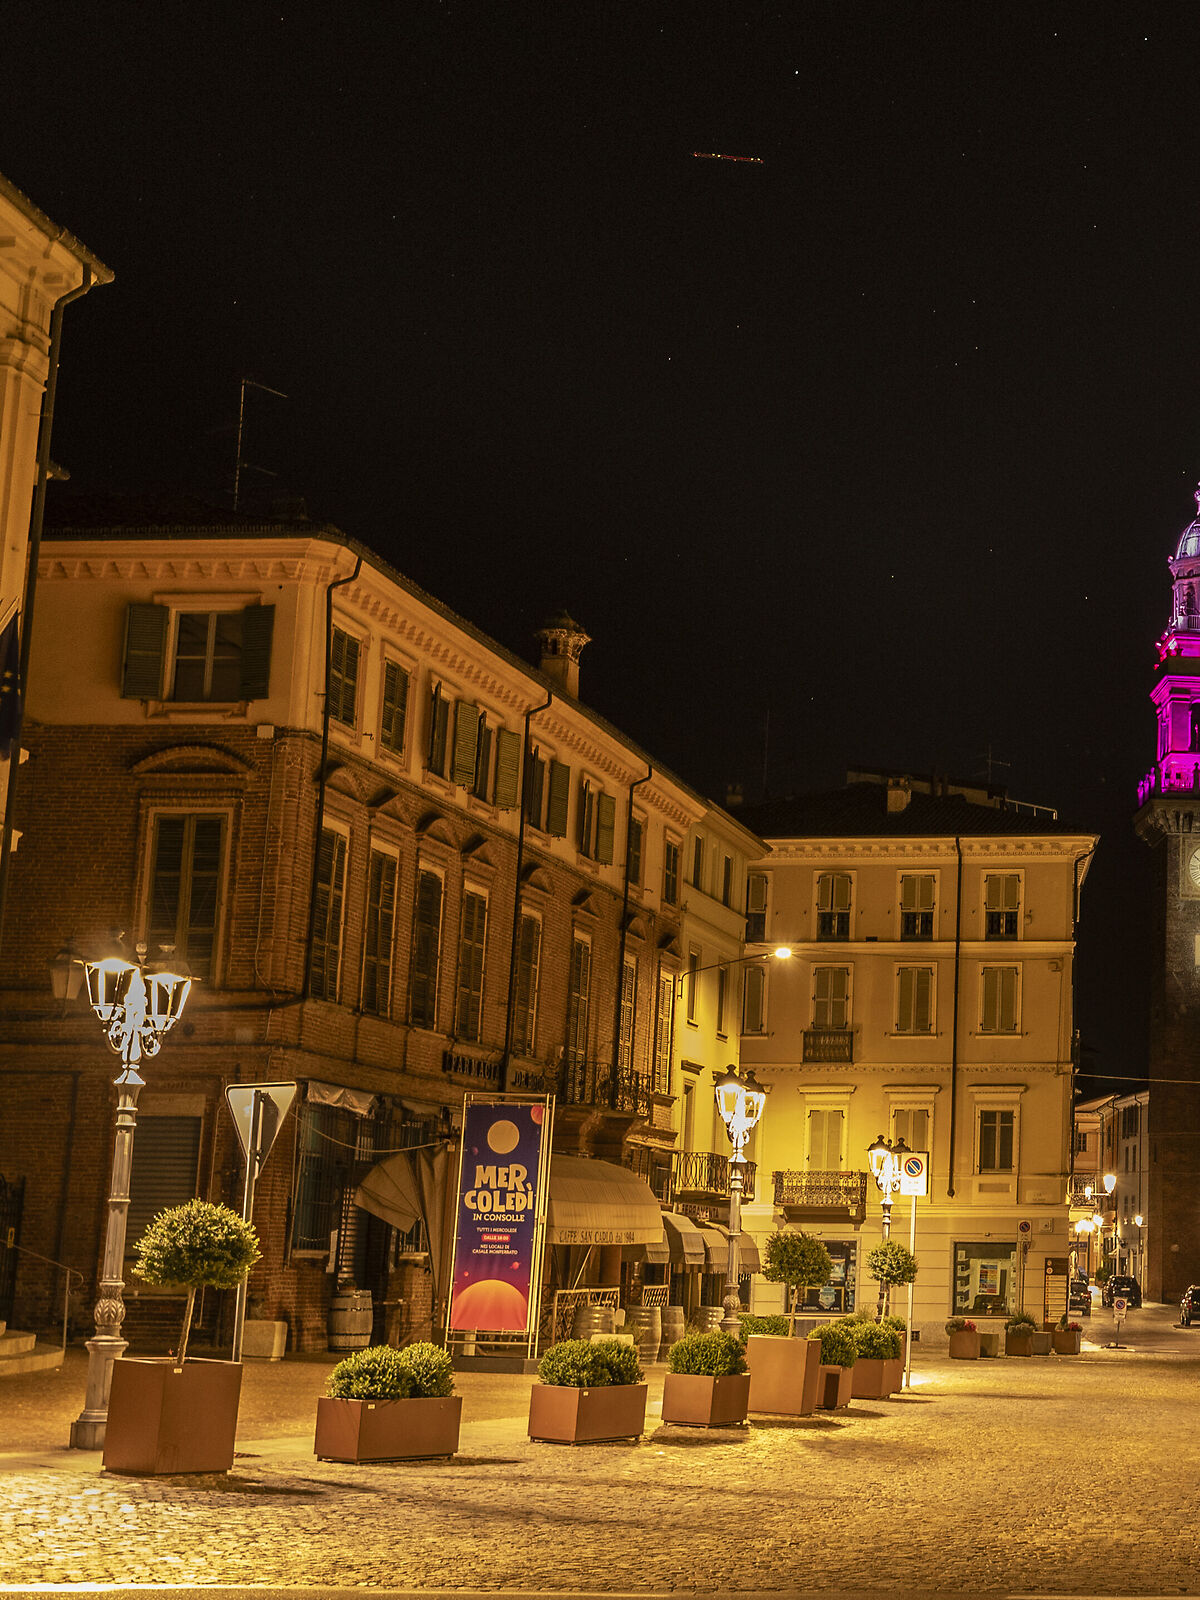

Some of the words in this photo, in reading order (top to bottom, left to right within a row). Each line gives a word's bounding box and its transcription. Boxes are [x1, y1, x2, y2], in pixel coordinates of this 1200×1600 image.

[473, 1213, 482, 1221] IN
[483, 1213, 525, 1222] CONSOLLE
[580, 1231, 592, 1243] SAN
[594, 1231, 613, 1243] CARLO
